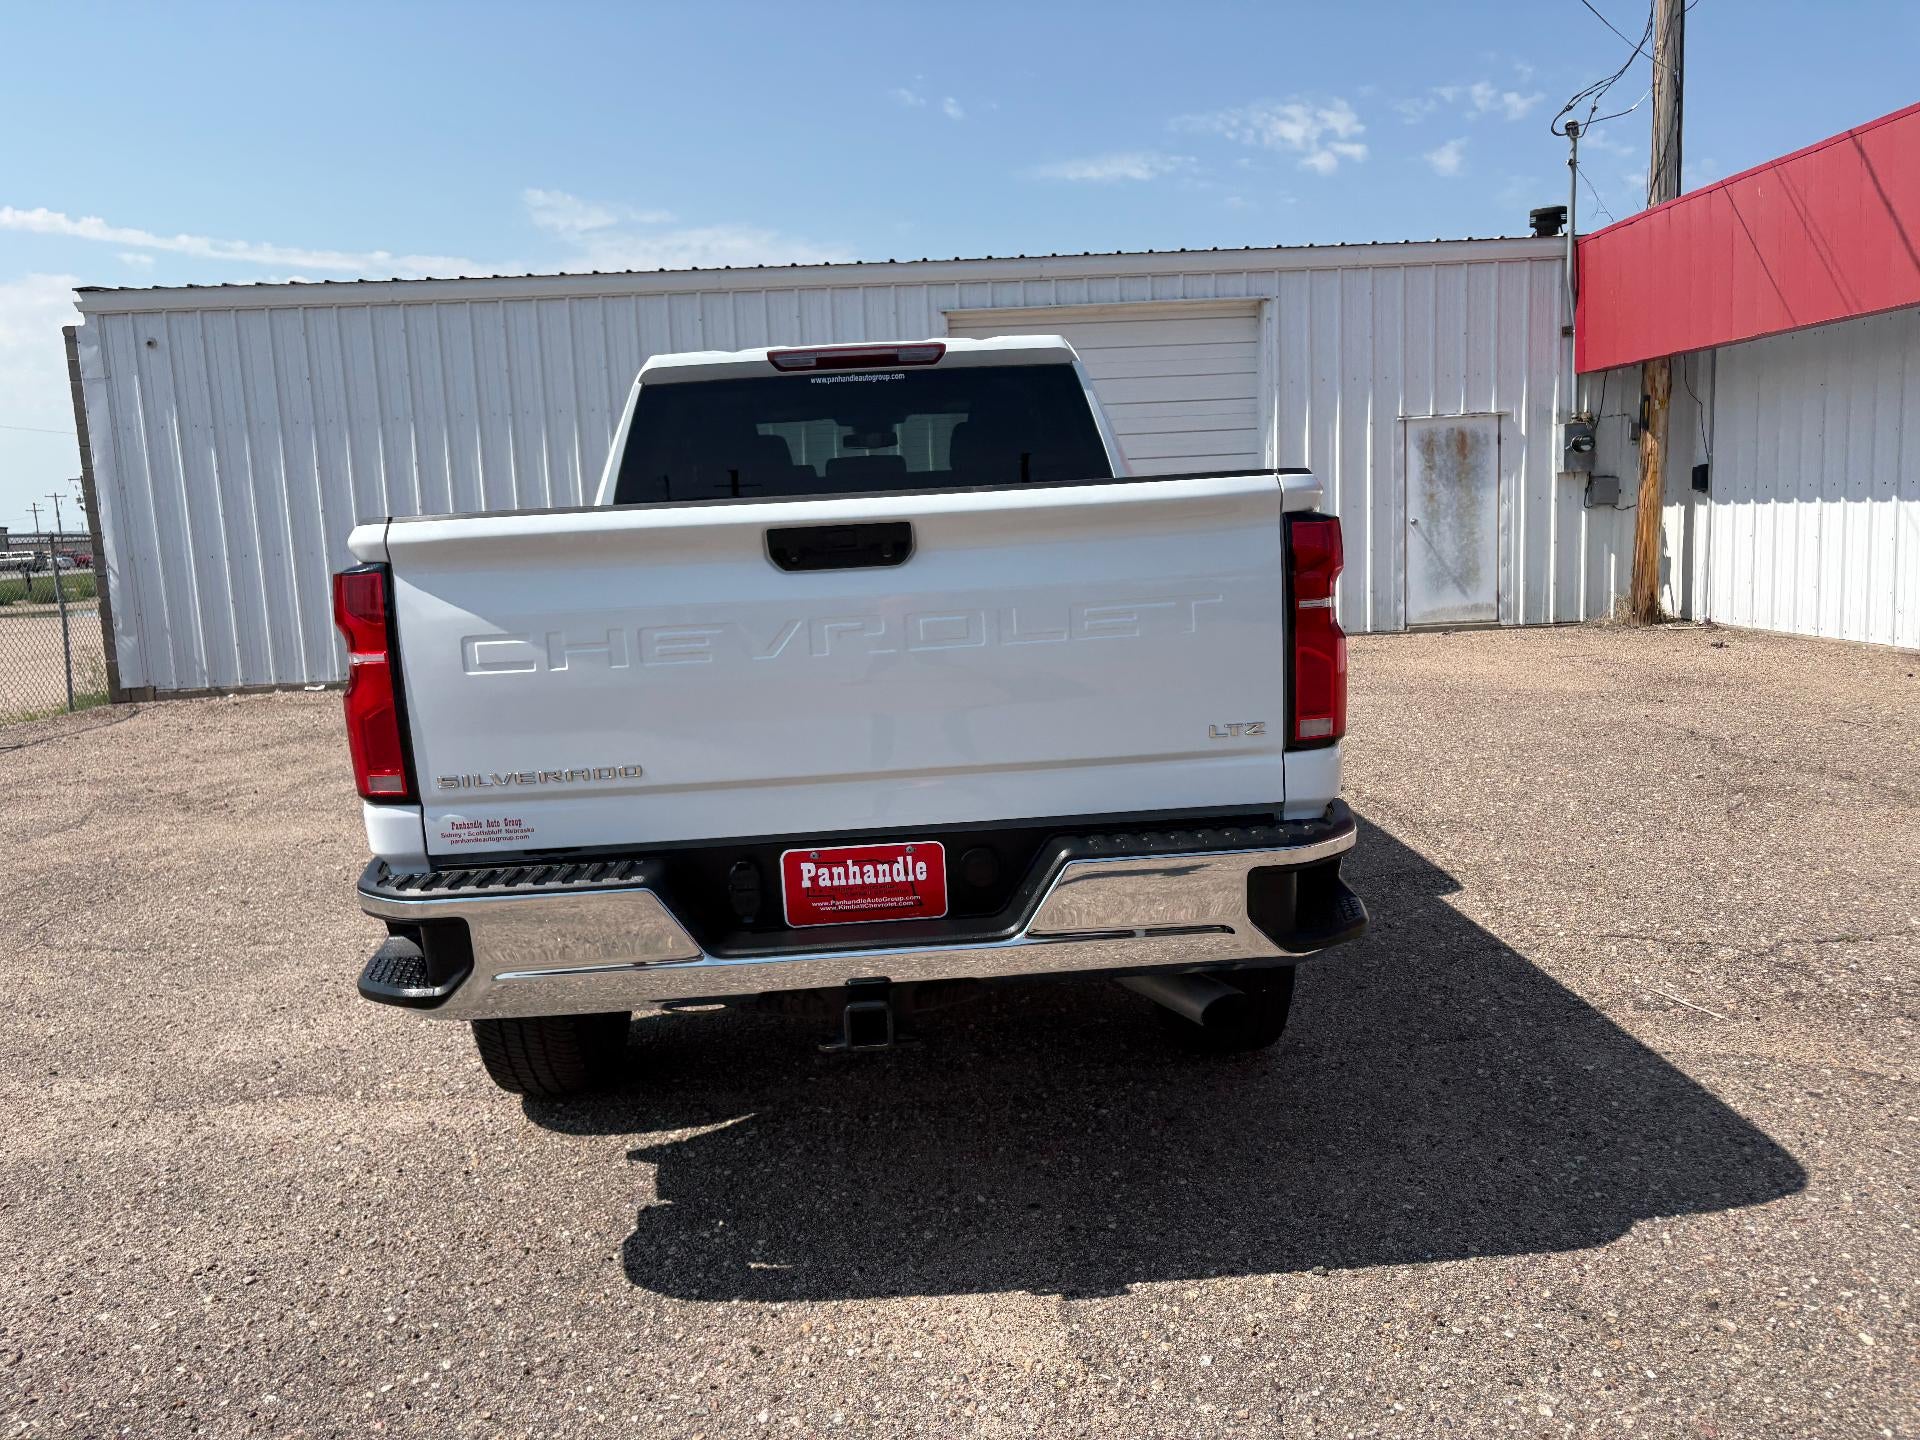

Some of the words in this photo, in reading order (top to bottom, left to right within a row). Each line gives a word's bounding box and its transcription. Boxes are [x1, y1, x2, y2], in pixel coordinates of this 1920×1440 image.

[810, 373, 905, 384] www.panhandleautogroup.com
[461, 594, 1223, 675] CHEVROLET
[1208, 722, 1266, 738] LTZ
[436, 765, 643, 789] SILVERADO
[451, 821, 482, 830] Panhandle
[486, 819, 500, 828] Auto
[504, 818, 522, 828] Group
[450, 834, 529, 845] panhandleautogroup.com
[800, 855, 927, 888] Panhandle
[811, 895, 921, 907] www.PanhandleAutoGroup.com
[819, 901, 914, 911] www.KimballChevrolet.com
